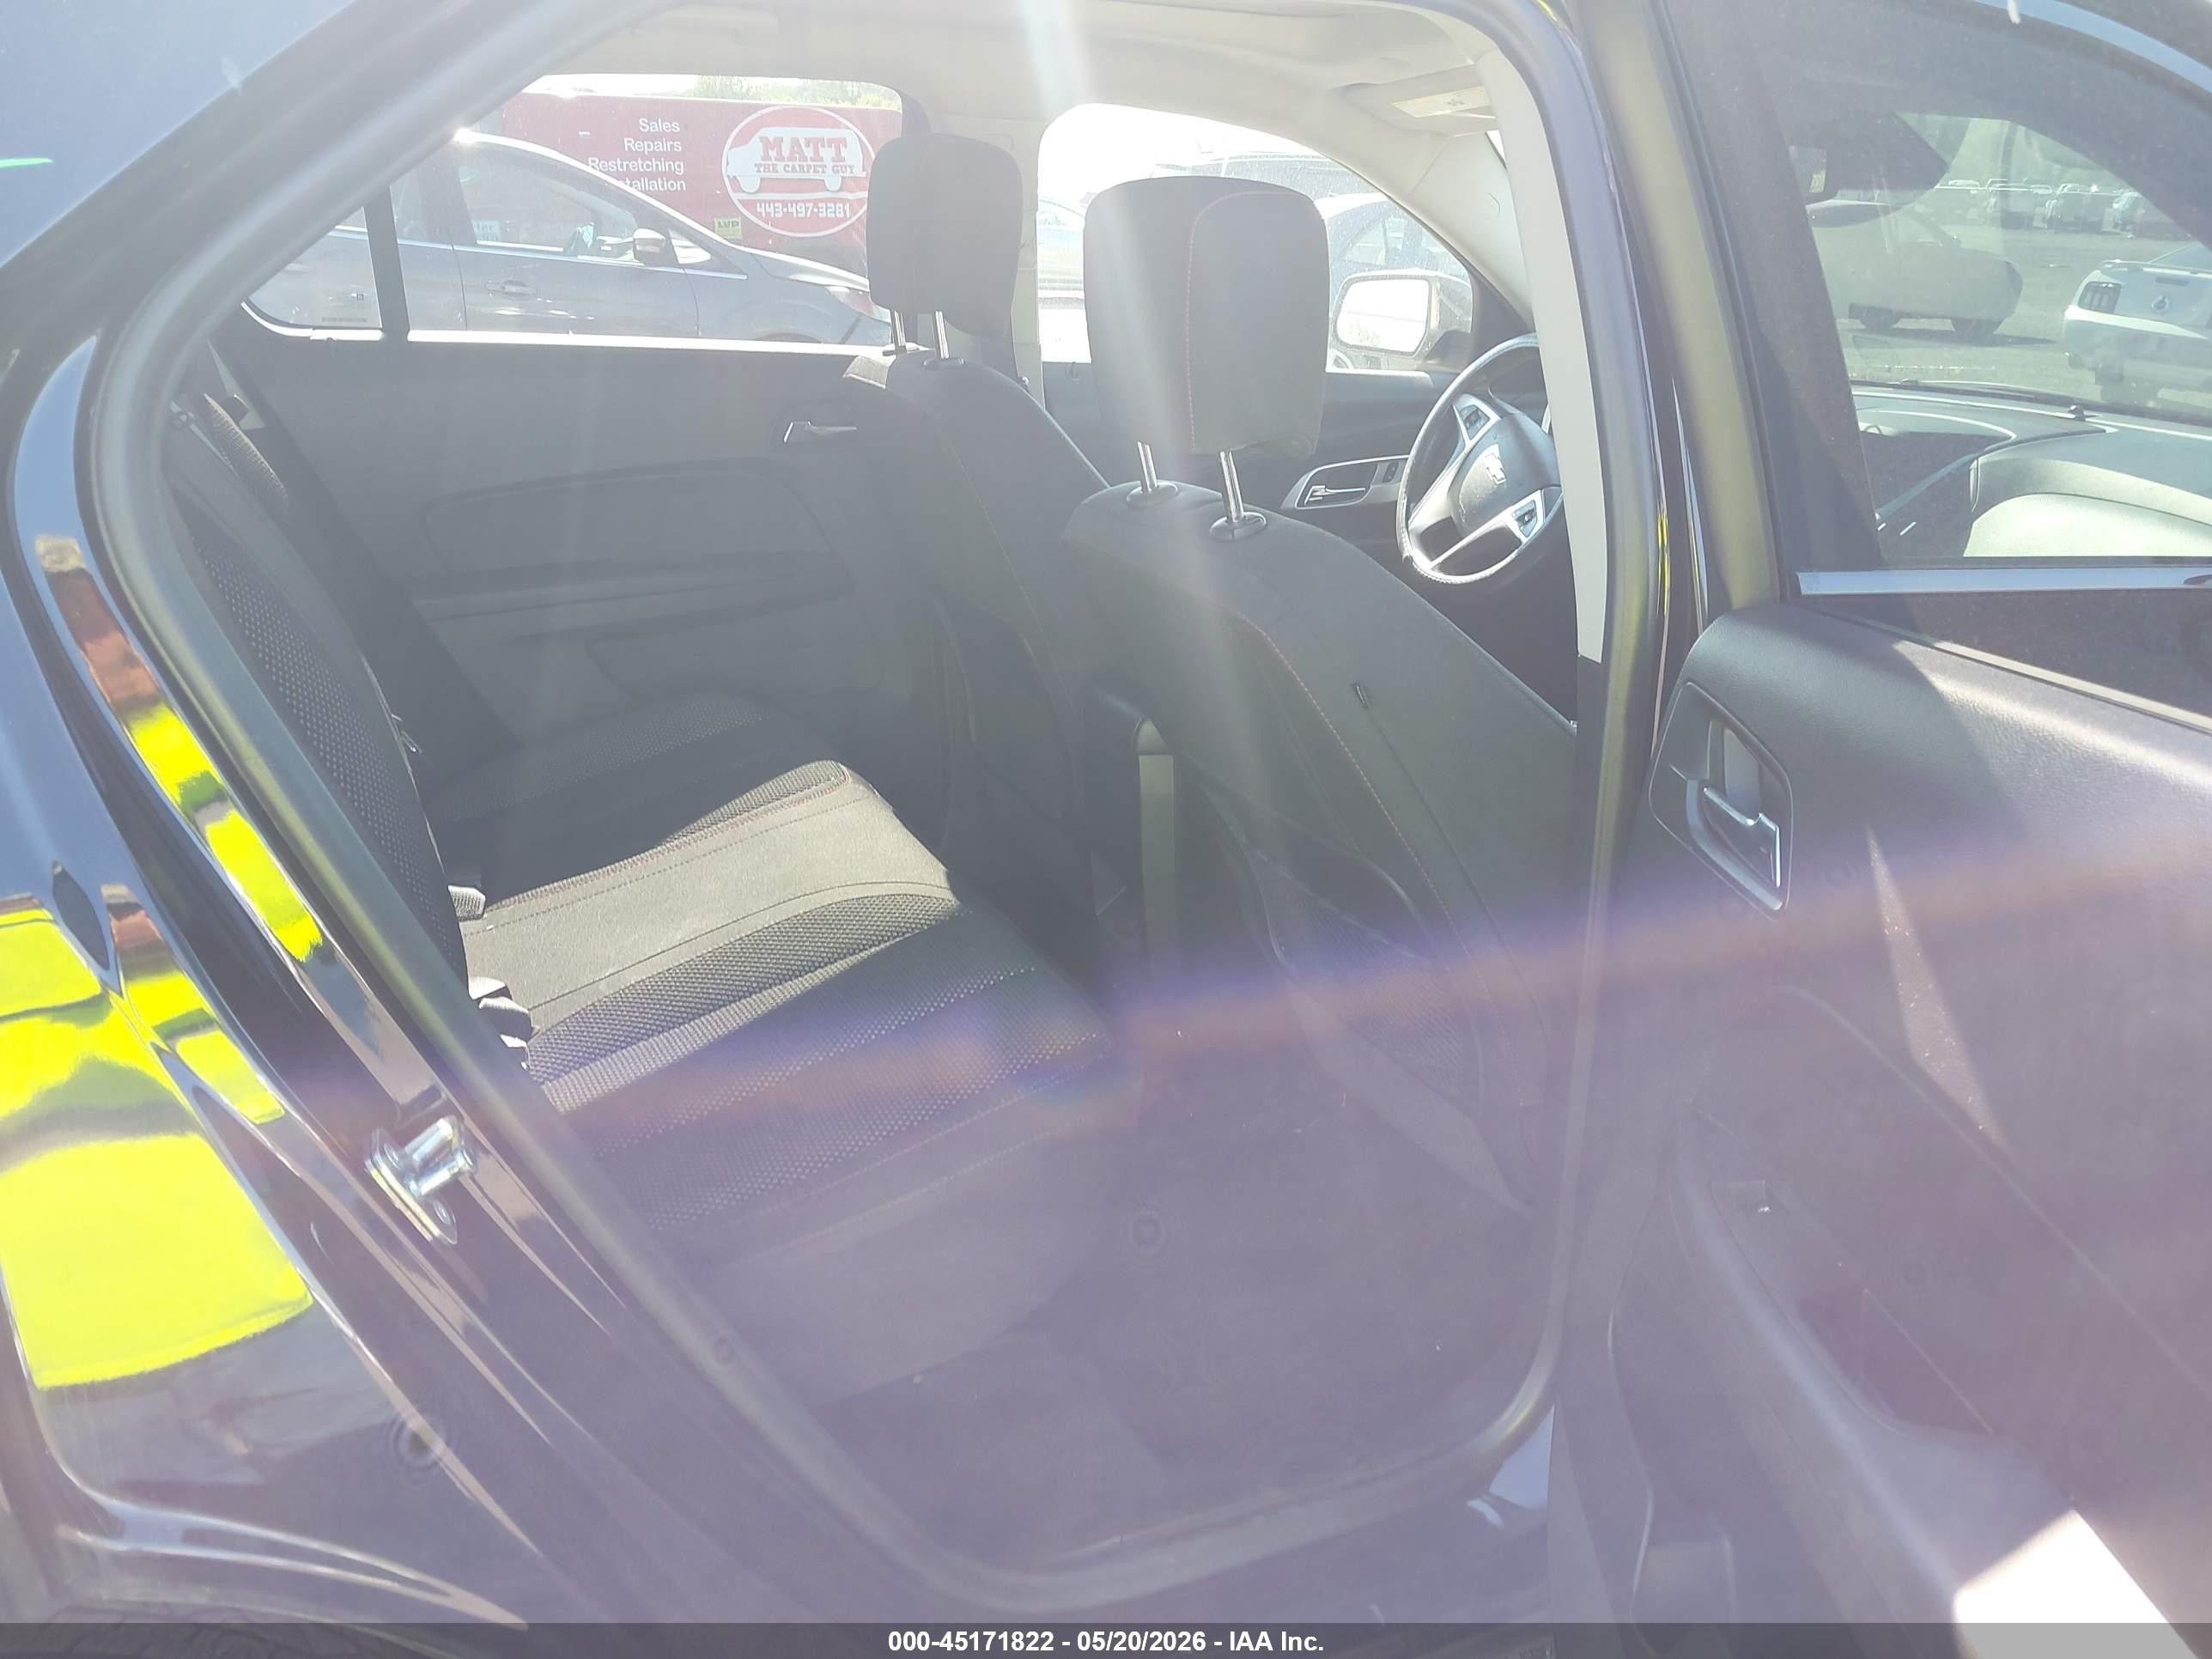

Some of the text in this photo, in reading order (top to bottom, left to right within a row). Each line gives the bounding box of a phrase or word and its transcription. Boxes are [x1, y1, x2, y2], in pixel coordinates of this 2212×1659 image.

[639, 118, 680, 132] Sales
[623, 137, 682, 155] Repairs
[758, 136, 848, 163] MATT
[588, 157, 684, 174] Restretching
[755, 163, 855, 174] THE CARPET GUY
[619, 177, 686, 191] tallation
[757, 203, 850, 218] 443-497-3281
